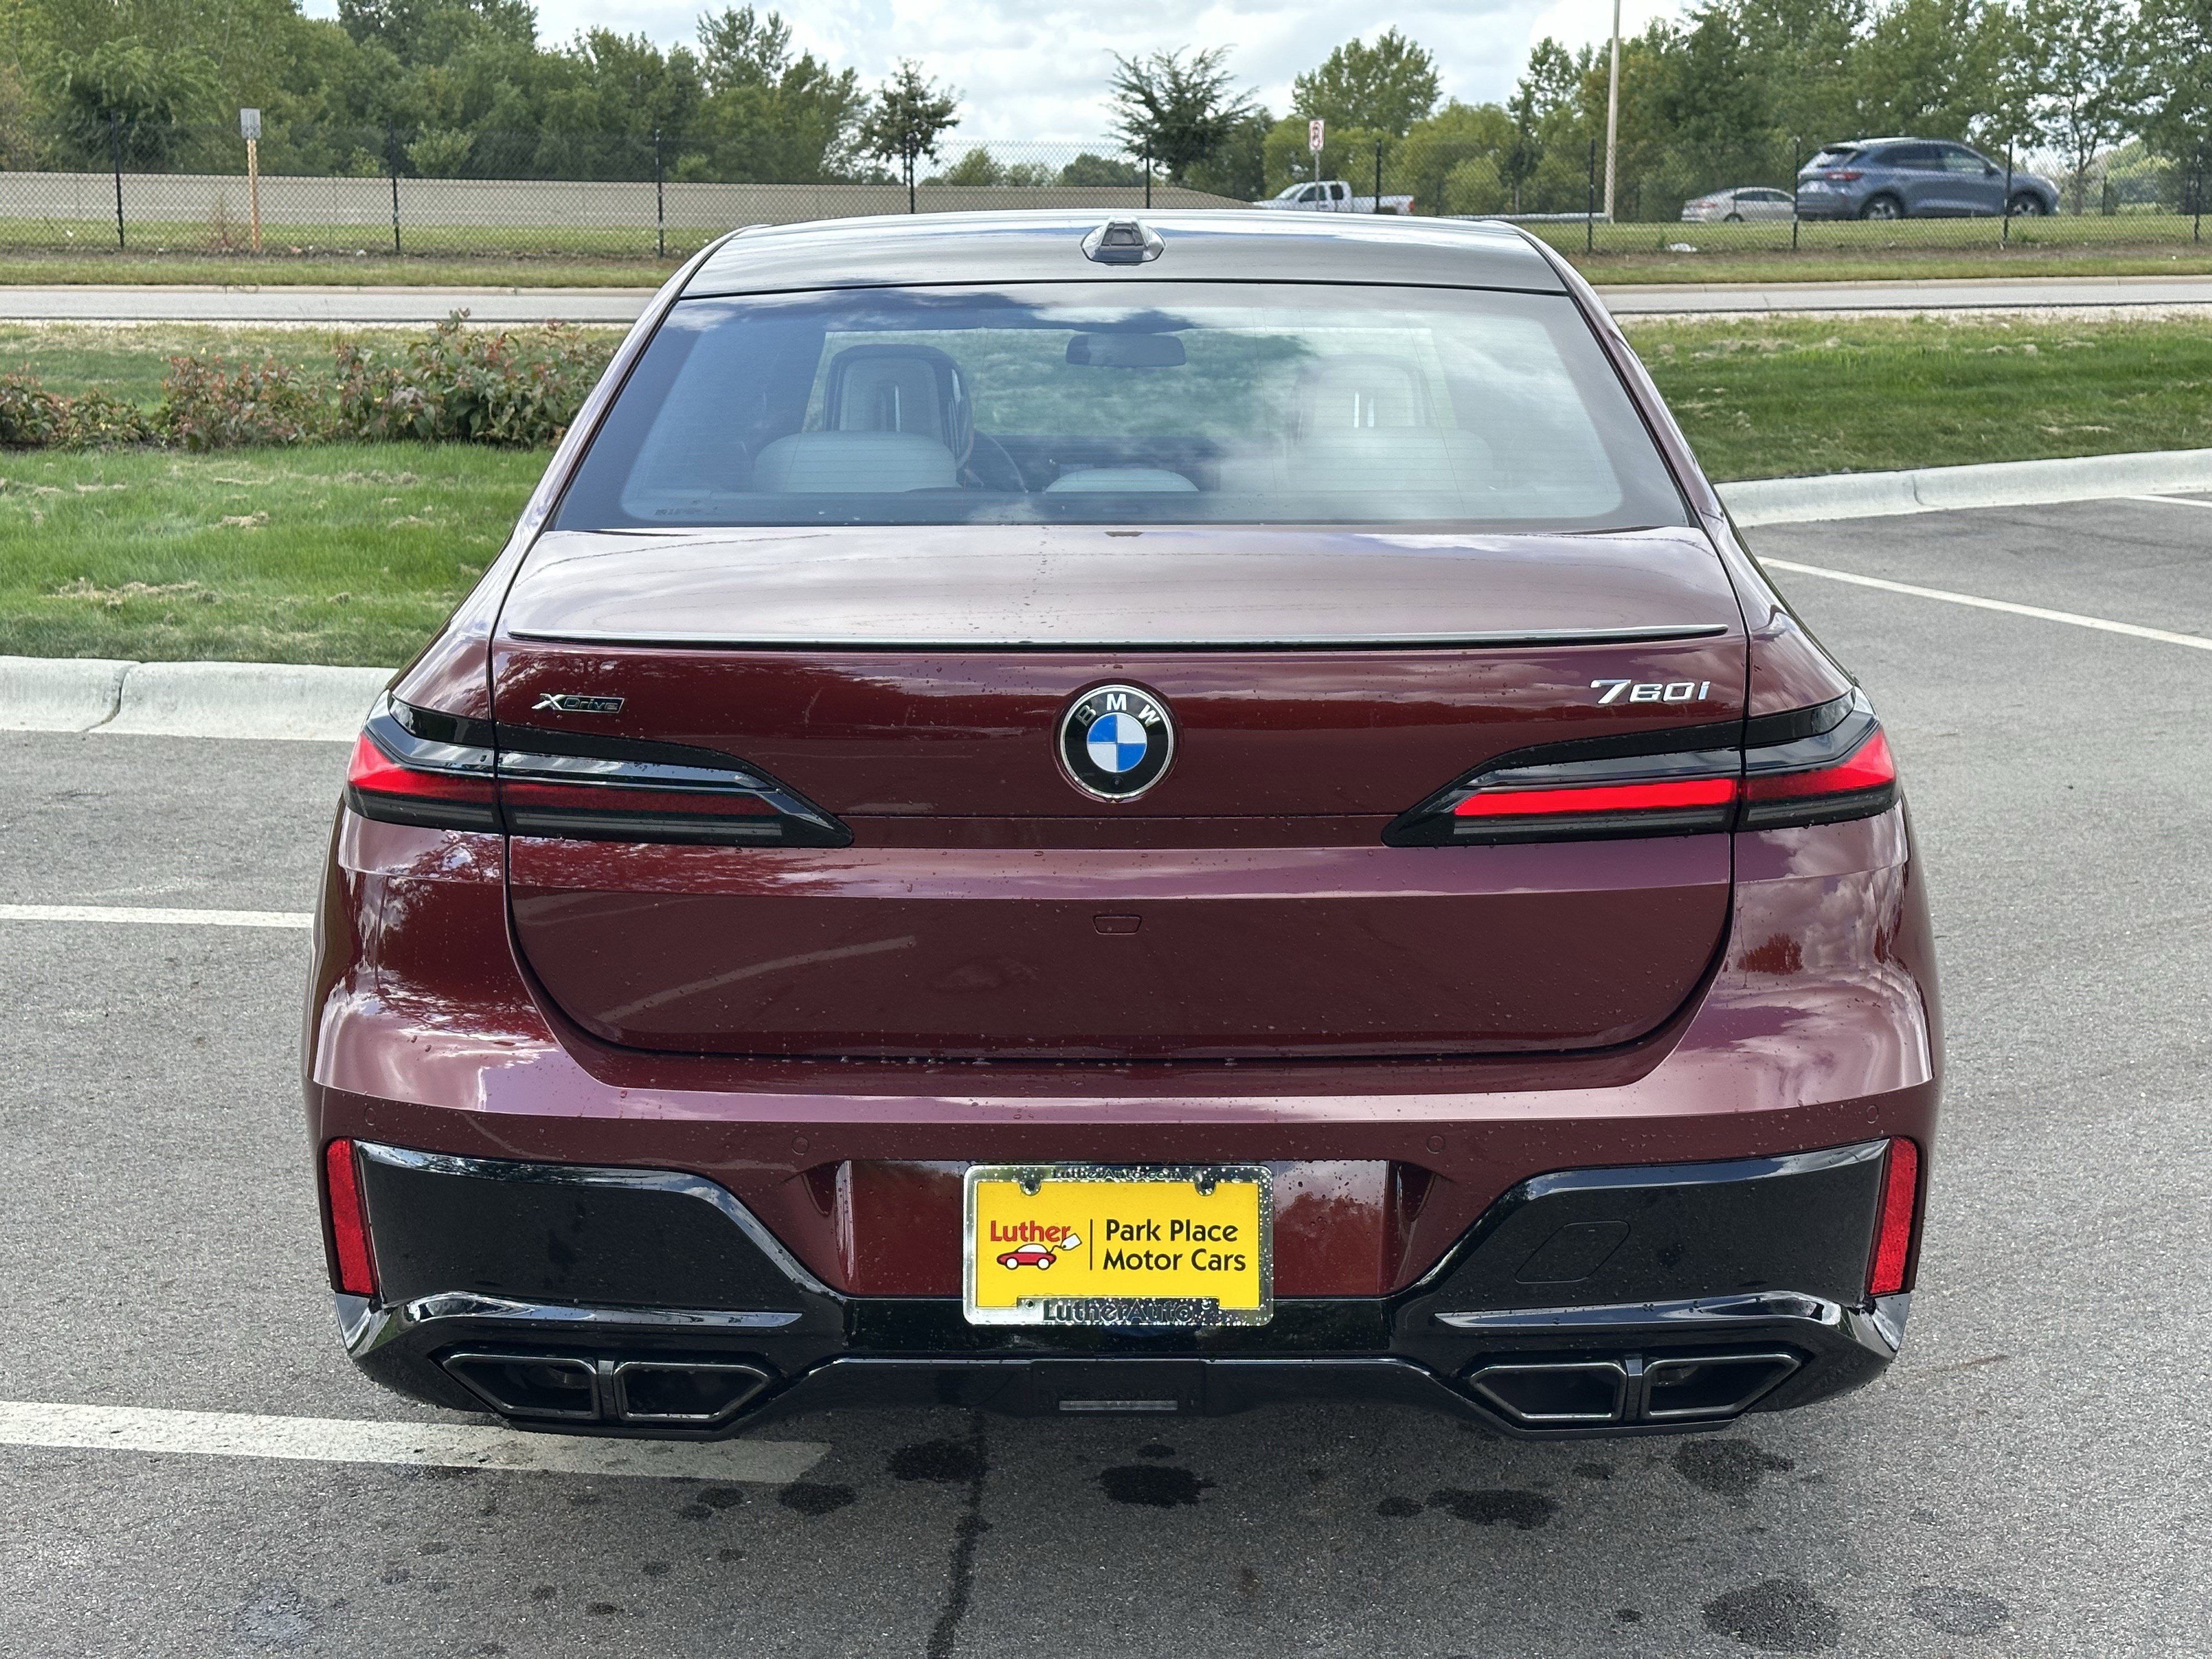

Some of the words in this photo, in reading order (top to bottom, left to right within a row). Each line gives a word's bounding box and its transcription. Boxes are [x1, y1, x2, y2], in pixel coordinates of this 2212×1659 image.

[1590, 679, 1711, 704] 760i
[1075, 693, 1160, 727] BMW
[990, 1220, 1071, 1242] Luther
[1106, 1218, 1161, 1242] Park
[1170, 1218, 1238, 1242] Place
[1103, 1248, 1182, 1271] Motor
[1191, 1248, 1246, 1271] Cars
[1042, 1298, 1195, 1323] LutherAuto
